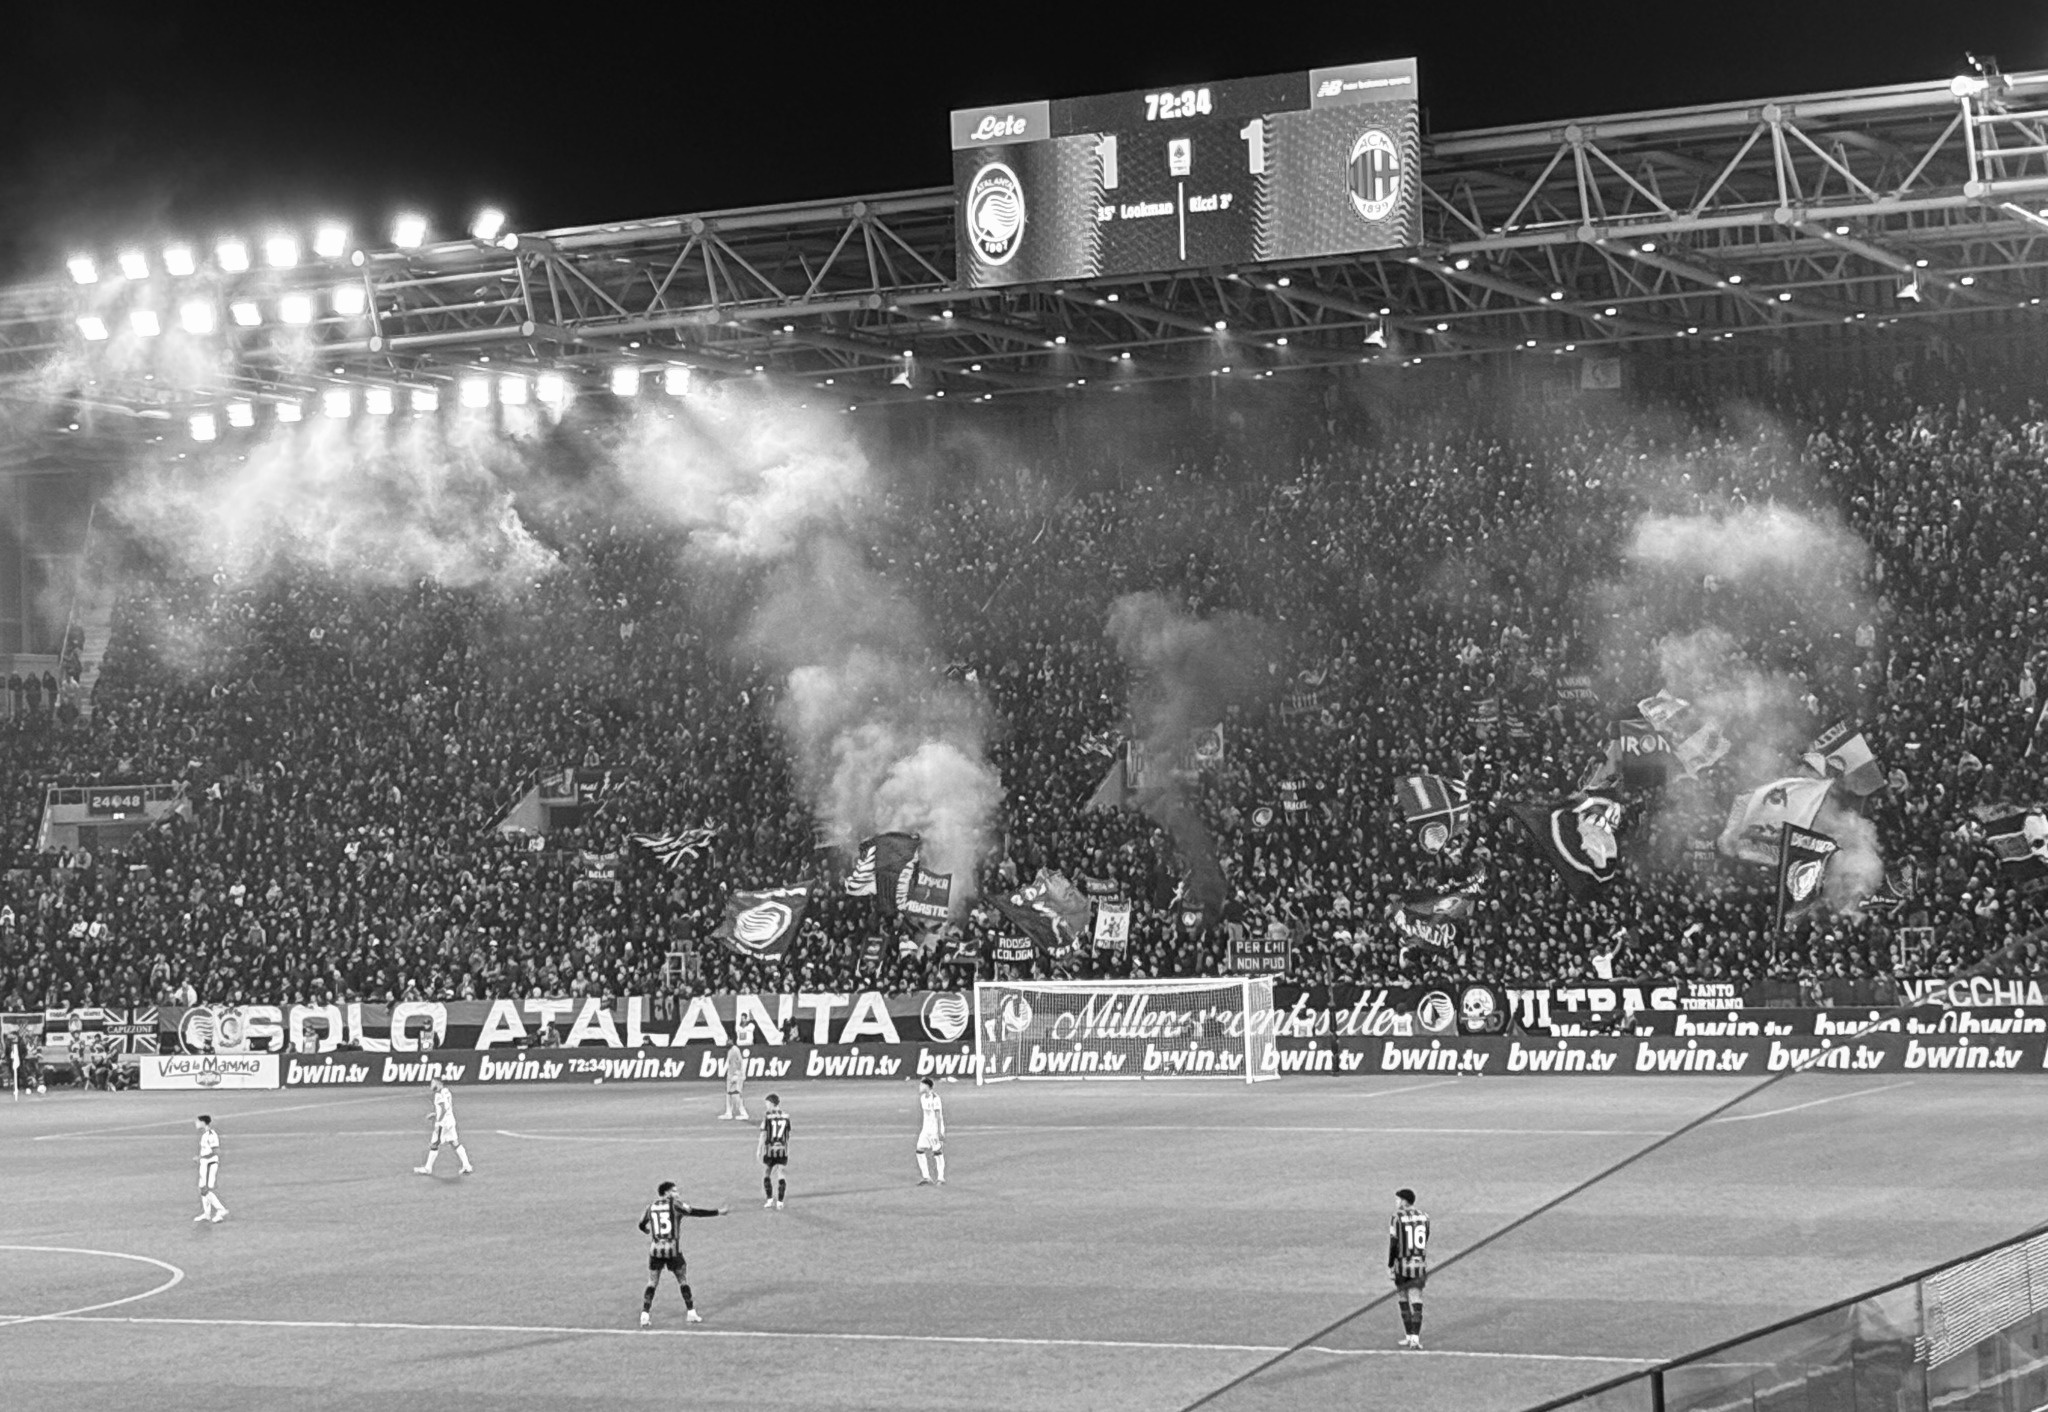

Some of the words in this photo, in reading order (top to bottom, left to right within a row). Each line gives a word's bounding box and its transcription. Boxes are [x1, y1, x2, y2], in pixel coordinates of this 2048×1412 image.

[1145, 88, 1212, 121] 72:34
[971, 115, 1026, 140] Lete
[1240, 119, 1264, 174] 1
[1358, 134, 1389, 152] ACM
[1095, 135, 1118, 189] 1
[1120, 202, 1174, 219] Lookman
[1189, 194, 1217, 212] Ricci
[1362, 201, 1388, 213] 1899
[92, 796, 110, 808] 24
[122, 795, 140, 808] 48
[1236, 941, 1261, 954] PER
[1264, 941, 1285, 954] CHI
[1237, 957, 1260, 970] NON
[1680, 997, 1744, 1010] TORNANO
[1689, 984, 1734, 997] TANTO
[1902, 976, 2045, 1007] VECCHIA
[107, 1025, 153, 1034] CAPIZZONE
[242, 1002, 448, 1053] SOLO
[475, 991, 901, 1050] ATALANTA
[159, 1056, 191, 1077] Viva
[478, 1052, 564, 1081] bwin.tv
[568, 1058, 608, 1073] 72:34
[806, 1047, 902, 1077] bwin.tv
[1029, 1042, 1127, 1072] bwin.tv
[1143, 1041, 1244, 1072] bwin.tv
[1381, 1040, 1490, 1071] bwin.tv
[1507, 1039, 1617, 1072] bwin.tv
[1635, 1039, 1749, 1072] bwin.tv
[1767, 1038, 1885, 1071] bwin.tv
[1904, 1036, 2023, 1069] bwin.tv
[287, 1056, 369, 1085] bwin.tv
[382, 1054, 465, 1083] bwin.tv
[771, 1119, 787, 1138] 17
[1405, 1225, 1426, 1250] 16
